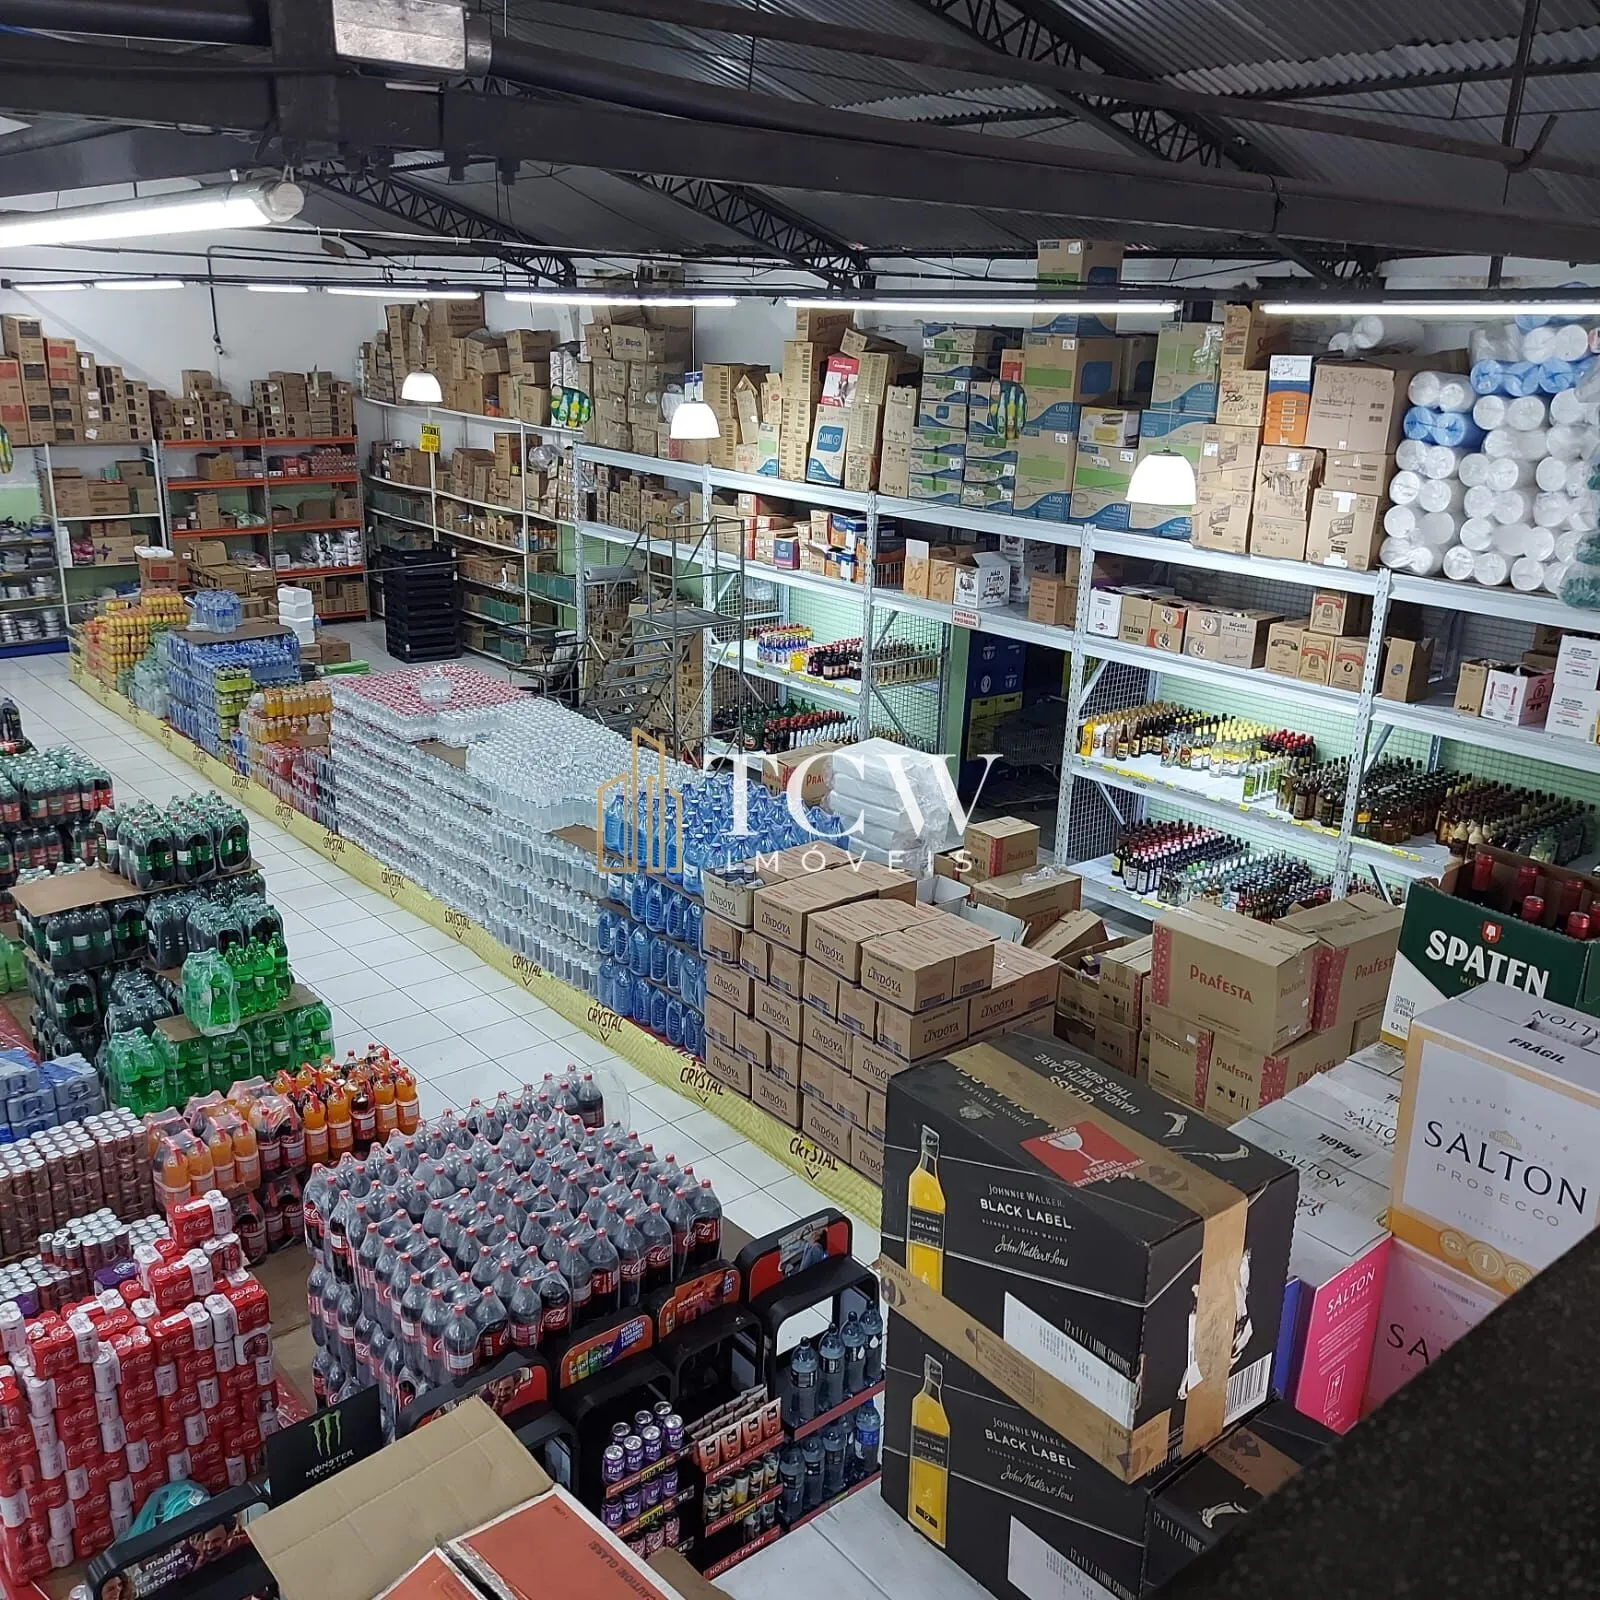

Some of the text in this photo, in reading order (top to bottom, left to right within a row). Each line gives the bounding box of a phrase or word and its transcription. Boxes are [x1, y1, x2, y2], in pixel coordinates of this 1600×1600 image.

[761, 911, 792, 936] LINDÓYA
[813, 938, 845, 965] LINDÓYA
[1424, 928, 1550, 1000] SPATEN
[511, 954, 542, 978] CRYSTAL
[867, 966, 902, 993] LINDÓYA
[713, 974, 741, 998] LINDÓYA
[587, 1006, 623, 1033] CRYSTAL
[762, 1001, 791, 1027] LINDÓYA
[812, 1027, 844, 1054] LINDÓYA
[923, 1022, 959, 1044] LINDÓYA
[1507, 1036, 1570, 1066] FRÁGIL
[679, 1066, 724, 1097] CRYSTAL
[712, 1055, 740, 1081] LINDÓYA
[1062, 1058, 1134, 1100] THIS SIDE UP
[1034, 1052, 1141, 1115] HANDLE WITH CARE
[759, 1085, 789, 1112] LINDÓYA
[810, 1116, 840, 1146] LINDÓYA
[1343, 1109, 1398, 1140] SALTO
[859, 1149, 882, 1174] LINDÓ
[1272, 1148, 1347, 1189] SALTON
[1423, 1120, 1588, 1216] SALTON
[987, 1182, 1025, 1202] JOHNNIE
[1436, 1162, 1561, 1228] PROSECCO
[979, 1197, 1073, 1231] BLACK LABEL
[1326, 1266, 1377, 1316] SALTON
[669, 1432, 685, 1444] FANT
[992, 1416, 1030, 1438] JOHNNIE
[645, 1443, 662, 1455] FANT
[984, 1428, 1078, 1470] BLACK LABEL
[305, 1448, 356, 1480] MONSTER
[607, 1462, 625, 1475] FANT
[144, 1547, 184, 1572] magia
[709, 1555, 730, 1575] NOITE
[730, 1548, 742, 1563] DE
[133, 1571, 150, 1586] de
